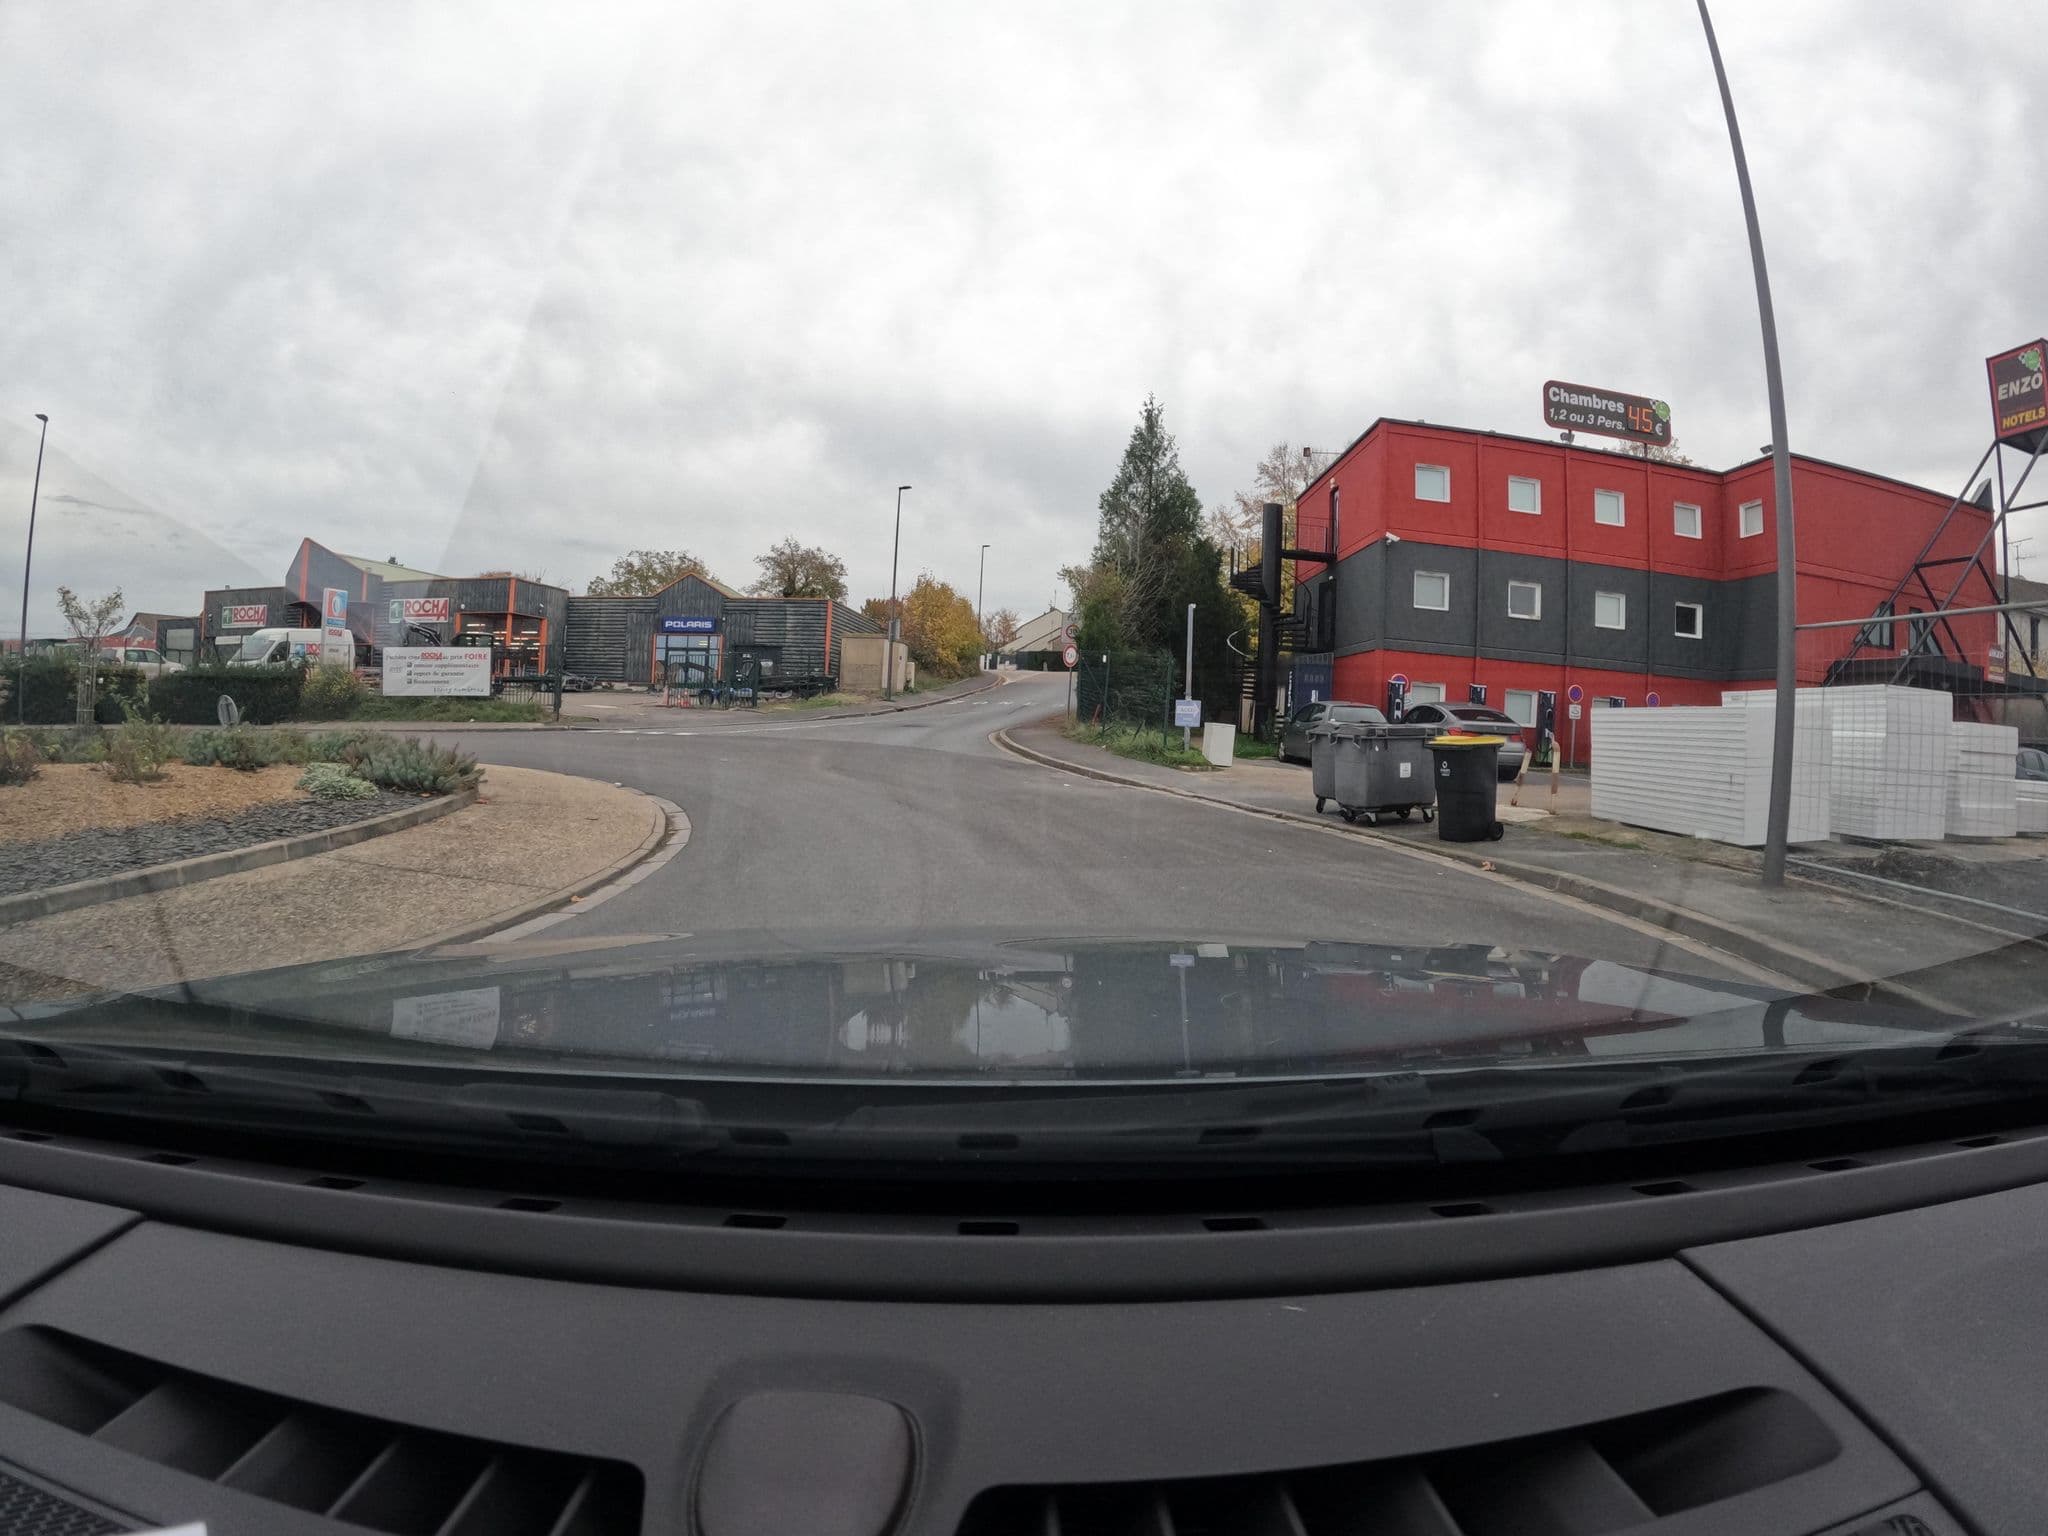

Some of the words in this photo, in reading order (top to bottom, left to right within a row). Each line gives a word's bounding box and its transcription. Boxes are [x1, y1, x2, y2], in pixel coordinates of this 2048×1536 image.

[1998, 373, 2043, 401] ENZO
[1549, 387, 1625, 413] Chambres
[1549, 408, 1567, 422] 1,2
[1569, 413, 1584, 423] ou
[1587, 414, 1595, 424] 3
[1597, 417, 1626, 431] Pers.
[1627, 405, 1653, 433] 45
[2002, 407, 2046, 430] HOTELS
[233, 606, 266, 625] ROCHA
[405, 600, 448, 621] ROCHA
[665, 620, 713, 629] POLARIS
[421, 652, 442, 660] ROCHA
[464, 652, 488, 660] FOIRE
